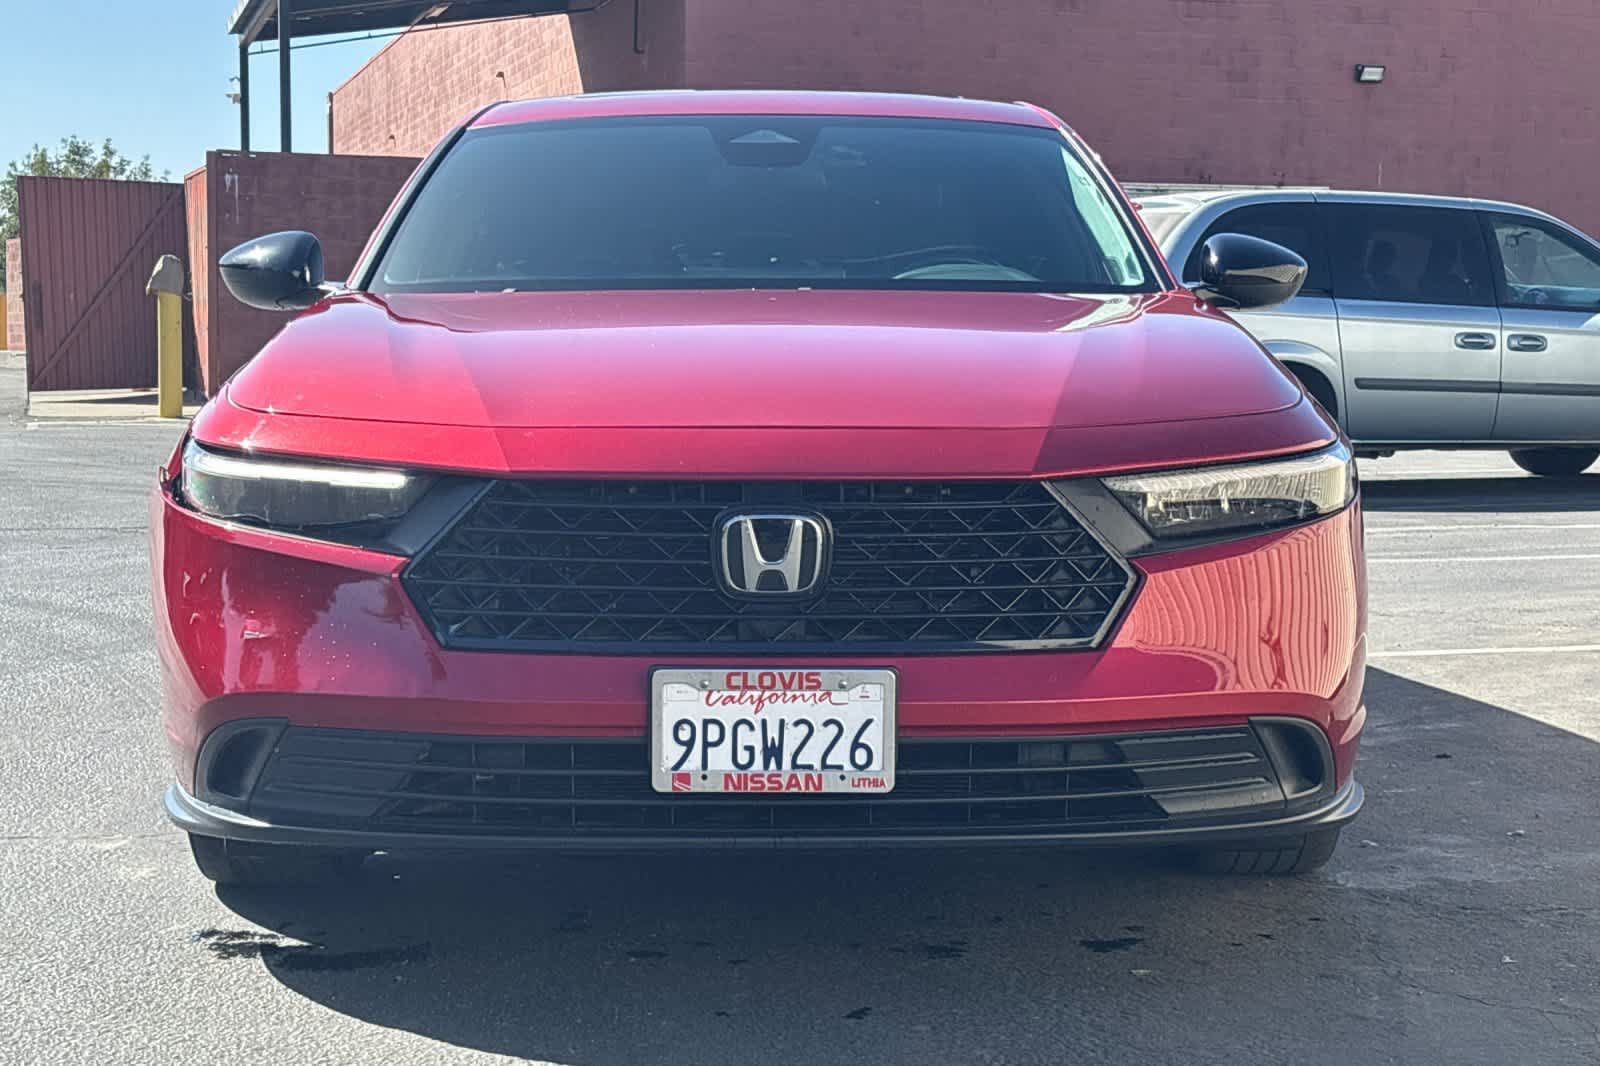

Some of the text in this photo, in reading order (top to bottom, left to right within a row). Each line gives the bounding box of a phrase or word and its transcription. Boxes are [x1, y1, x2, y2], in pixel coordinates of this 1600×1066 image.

[725, 672, 822, 690] CLOVIS
[705, 689, 848, 714] California
[671, 718, 874, 771] 9PGW226
[723, 773, 823, 791] NISSAN
[851, 777, 886, 788] LITHIA
